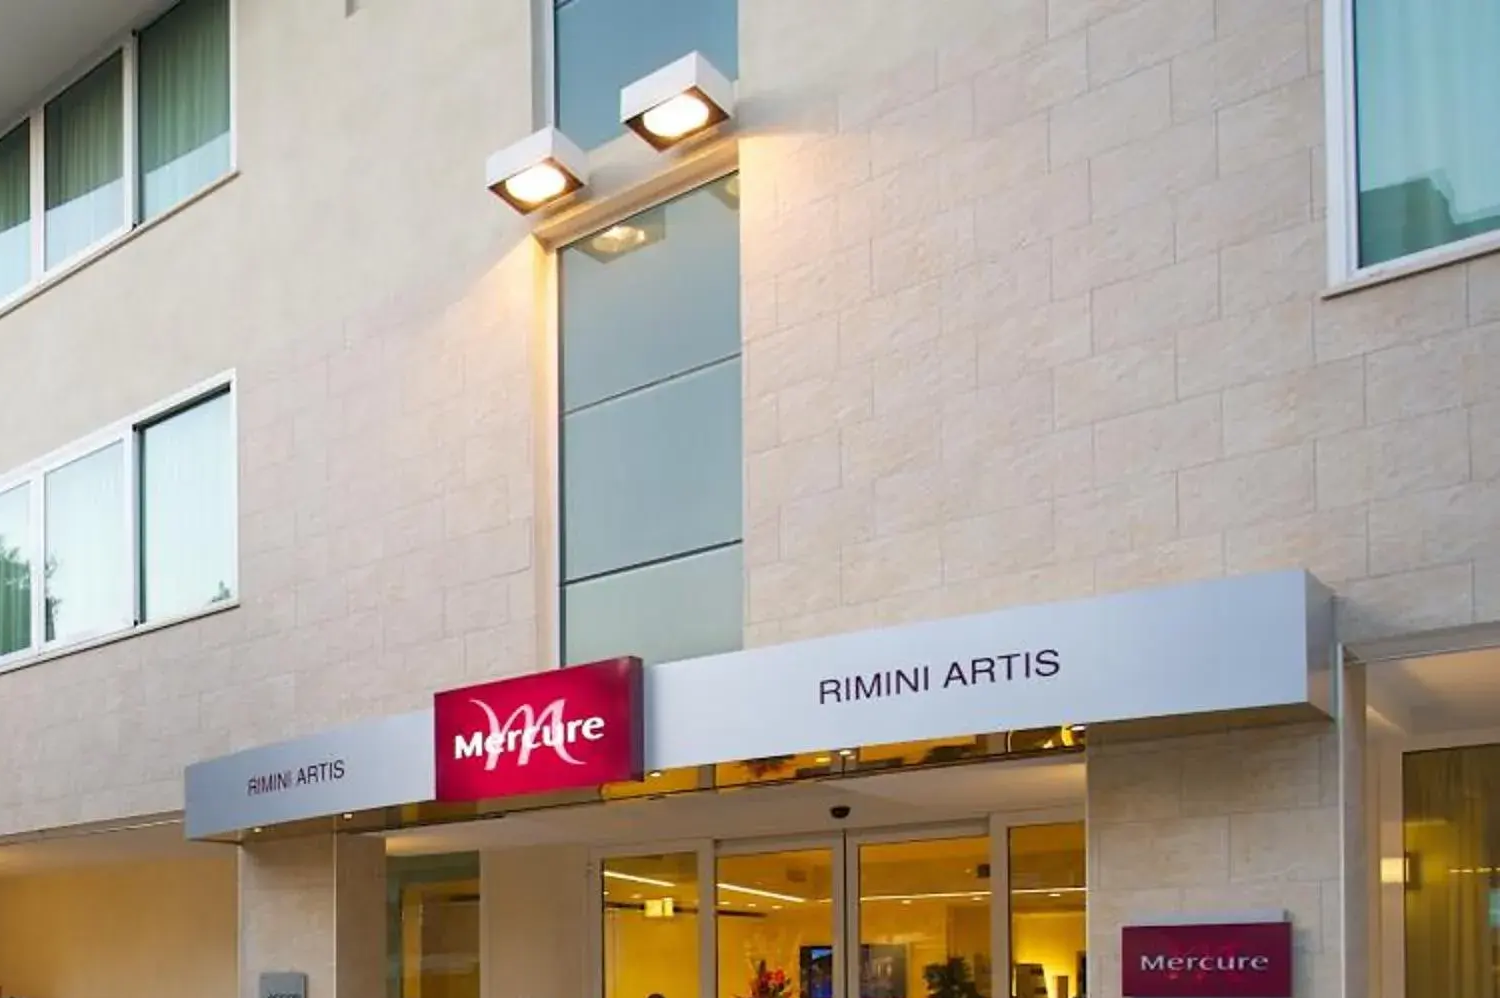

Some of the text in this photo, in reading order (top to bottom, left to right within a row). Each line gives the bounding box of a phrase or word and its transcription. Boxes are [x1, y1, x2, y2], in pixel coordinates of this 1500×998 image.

[819, 648, 1060, 705] RIMINI ARTIS
[454, 716, 605, 760] Mercure
[247, 759, 345, 796] RIMINI ARTIS
[1140, 954, 1269, 972] Mercure
